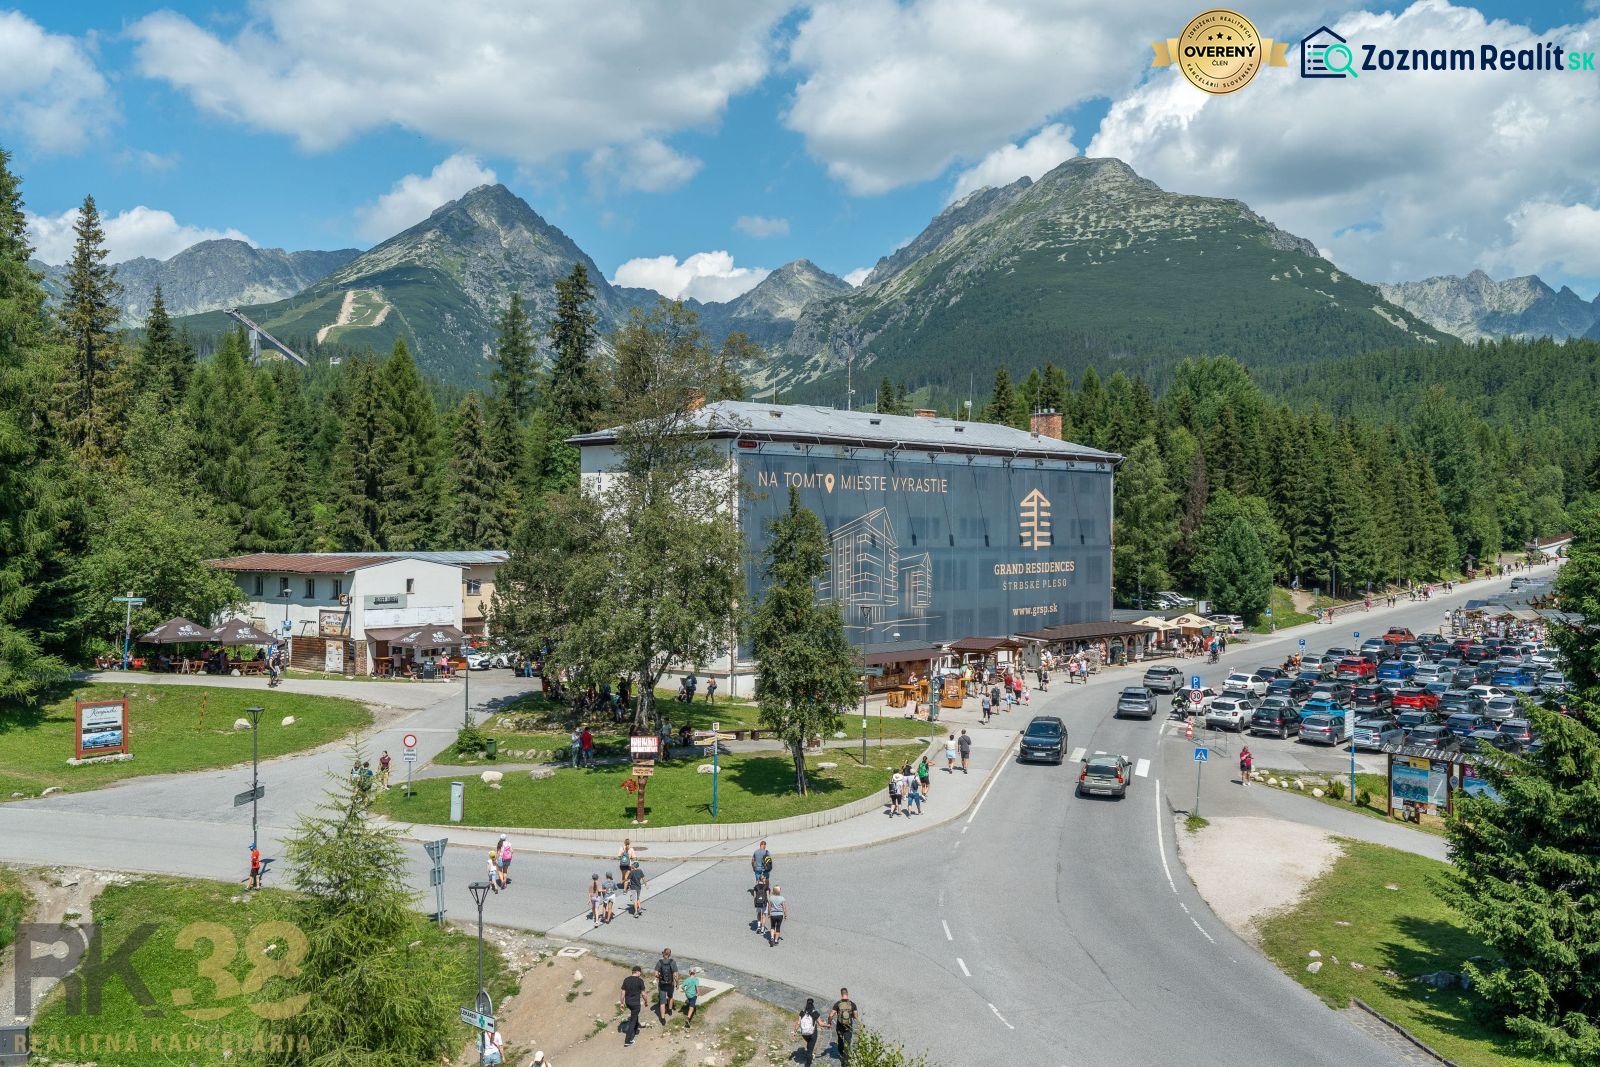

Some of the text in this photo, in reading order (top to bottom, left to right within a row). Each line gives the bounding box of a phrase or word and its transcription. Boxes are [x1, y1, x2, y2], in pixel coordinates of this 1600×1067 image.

[758, 471, 778, 487] NA
[841, 474, 887, 491] MIESTE
[891, 476, 948, 493] VYRASTIE
[994, 561, 1075, 575] GRAND RESIDENCES
[1002, 578, 1067, 590] ŠTRBSKÉ PLESO
[1012, 603, 1058, 616] www.grsp.sk
